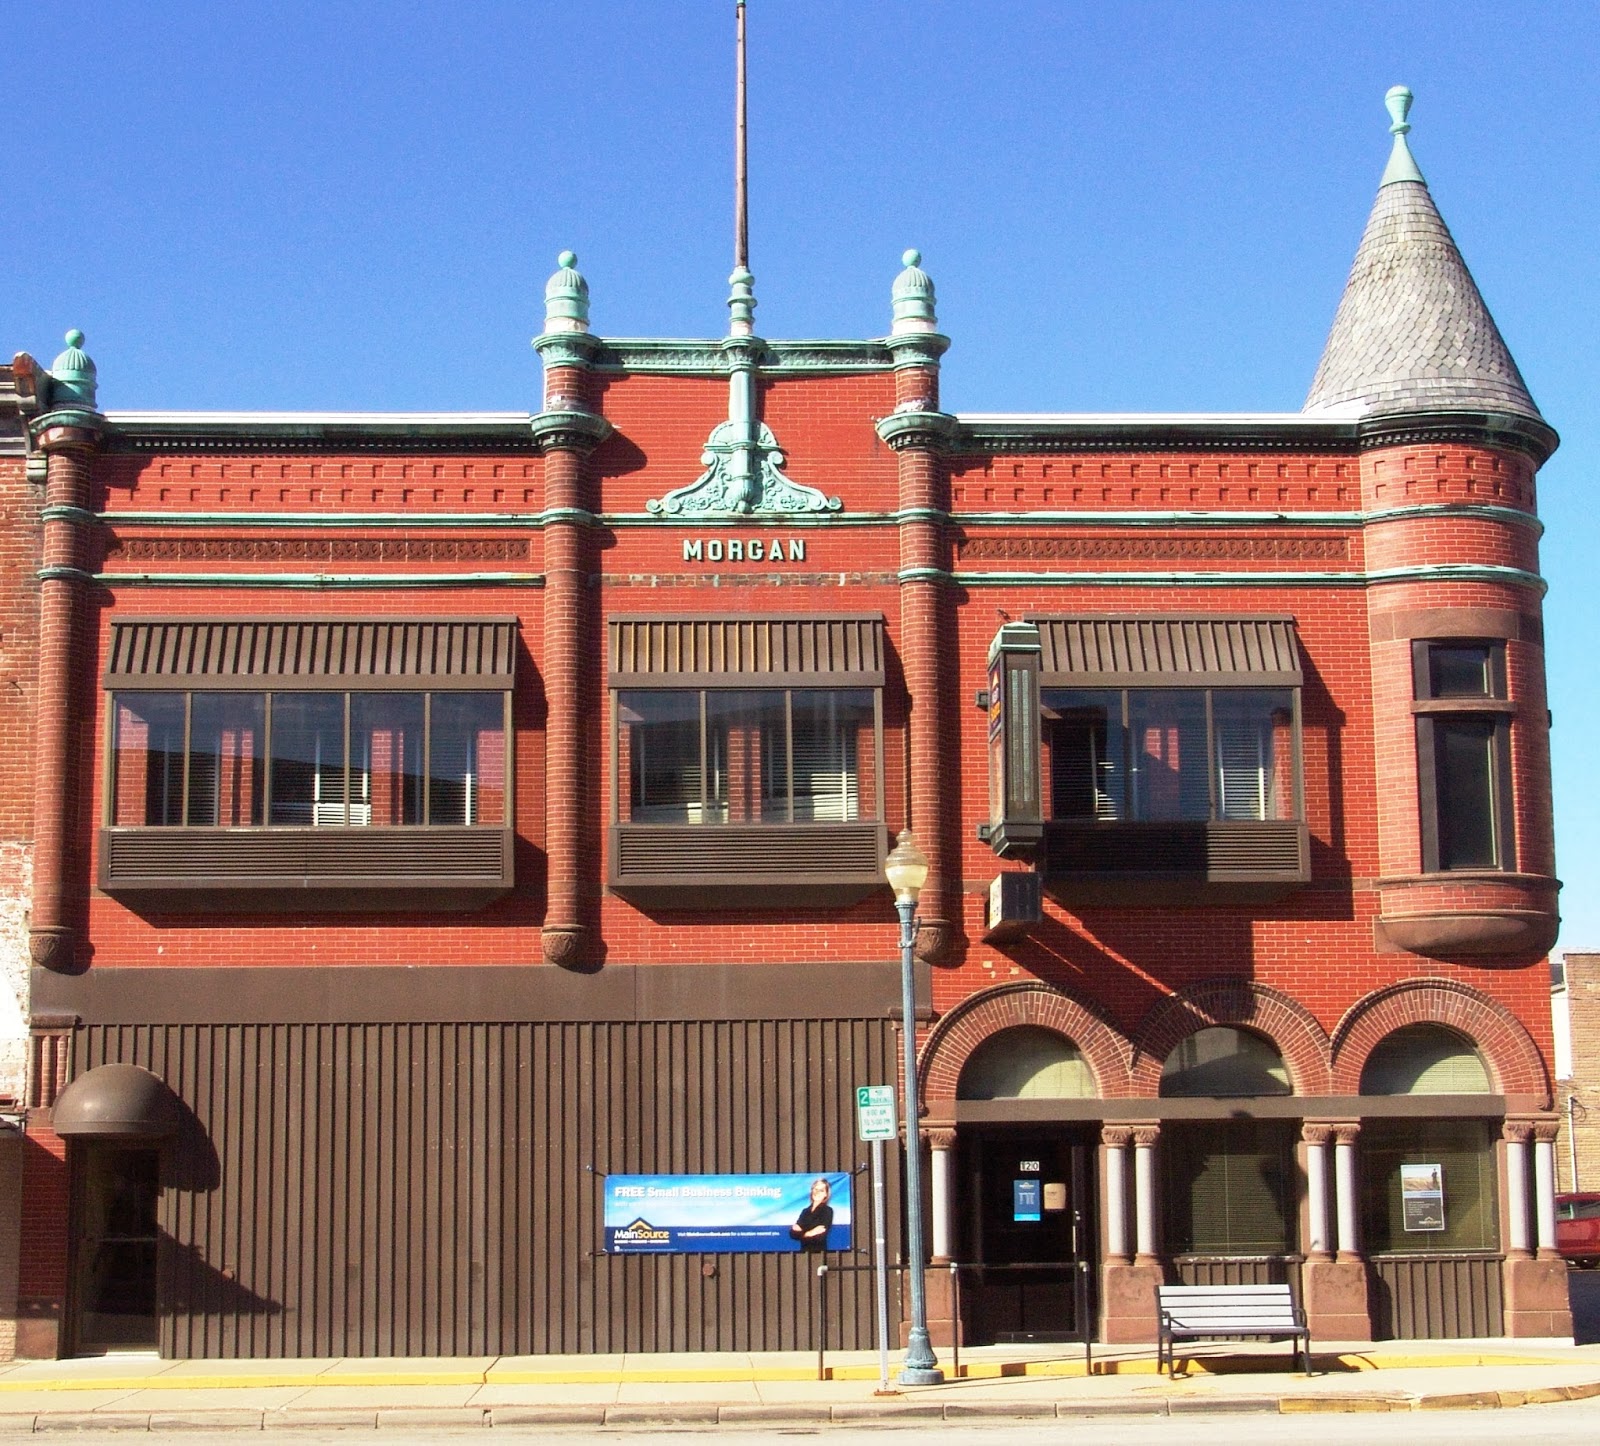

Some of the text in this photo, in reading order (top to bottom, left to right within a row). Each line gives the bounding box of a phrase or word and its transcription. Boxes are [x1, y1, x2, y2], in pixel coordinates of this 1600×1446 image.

[683, 539, 805, 561] MORGAN
[860, 1091, 869, 1104] 2
[1021, 1161, 1039, 1171] 120
[614, 1186, 782, 1199] FREE Small Business Banking
[614, 1229, 670, 1239] MainSource
